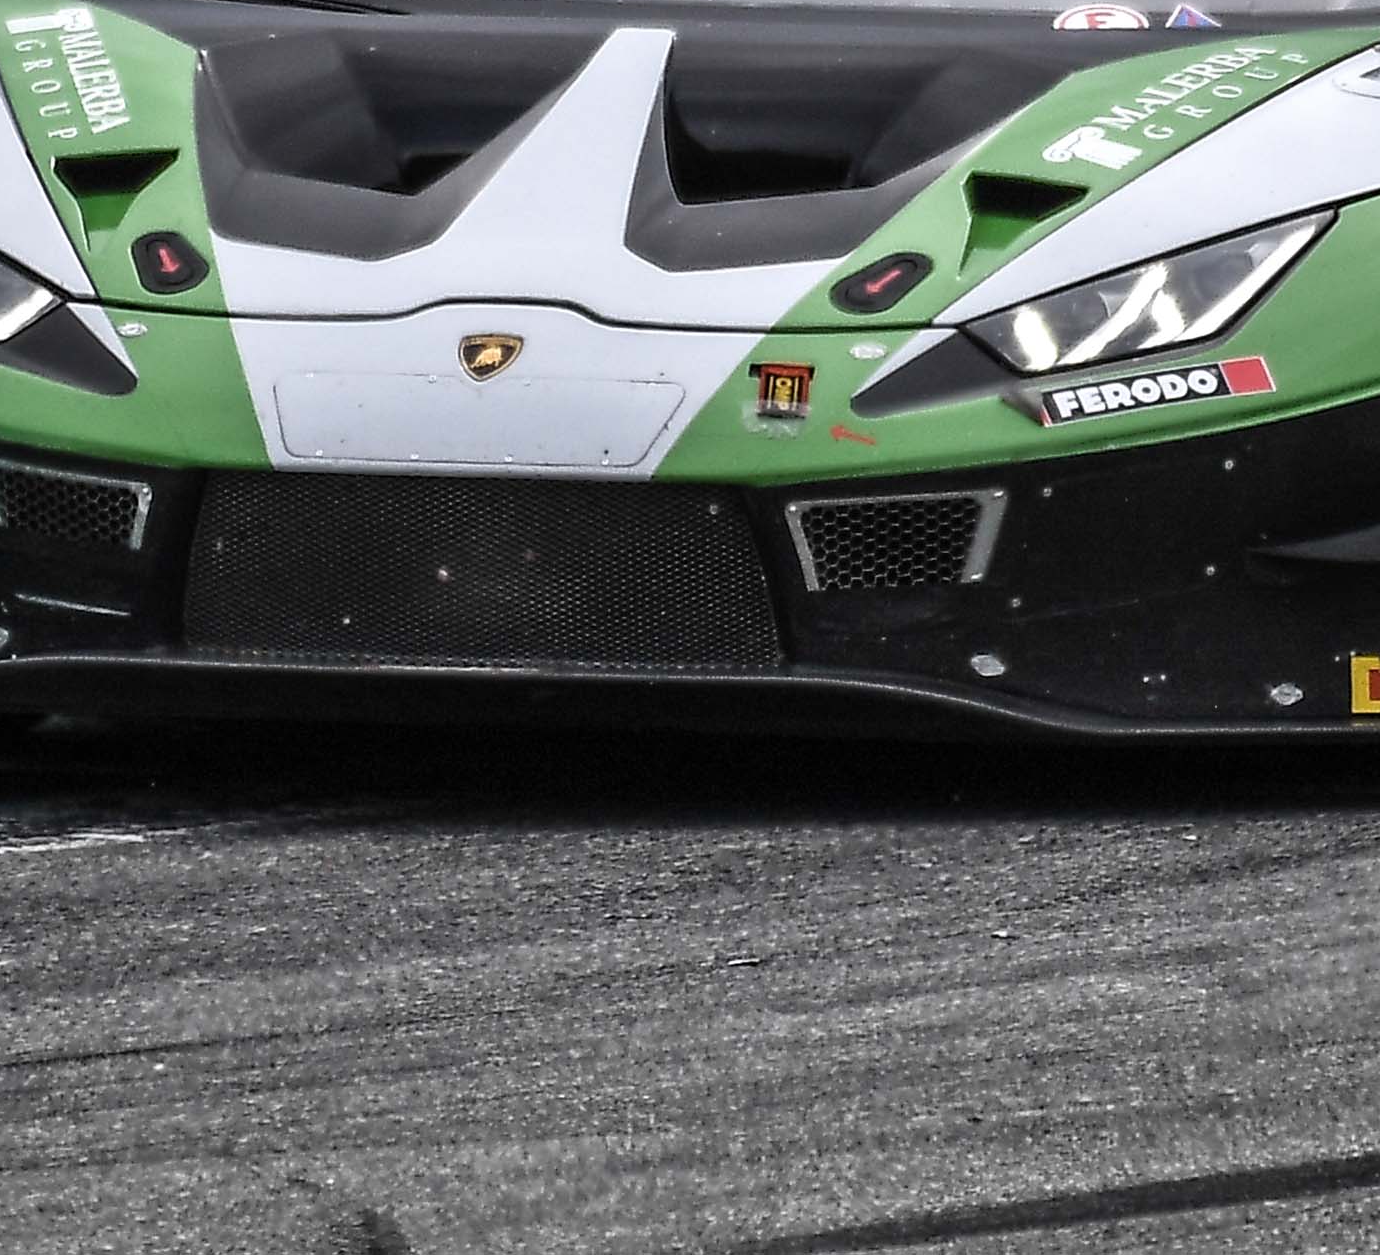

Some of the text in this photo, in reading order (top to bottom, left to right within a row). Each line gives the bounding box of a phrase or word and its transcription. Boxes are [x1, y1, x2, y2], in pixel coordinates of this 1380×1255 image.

[15, 38, 78, 139] GROUP
[58, 29, 131, 135] MALERBA
[1092, 45, 1277, 131] MALERBA
[1144, 52, 1309, 140] GROUP
[1051, 369, 1218, 418] FERODO
